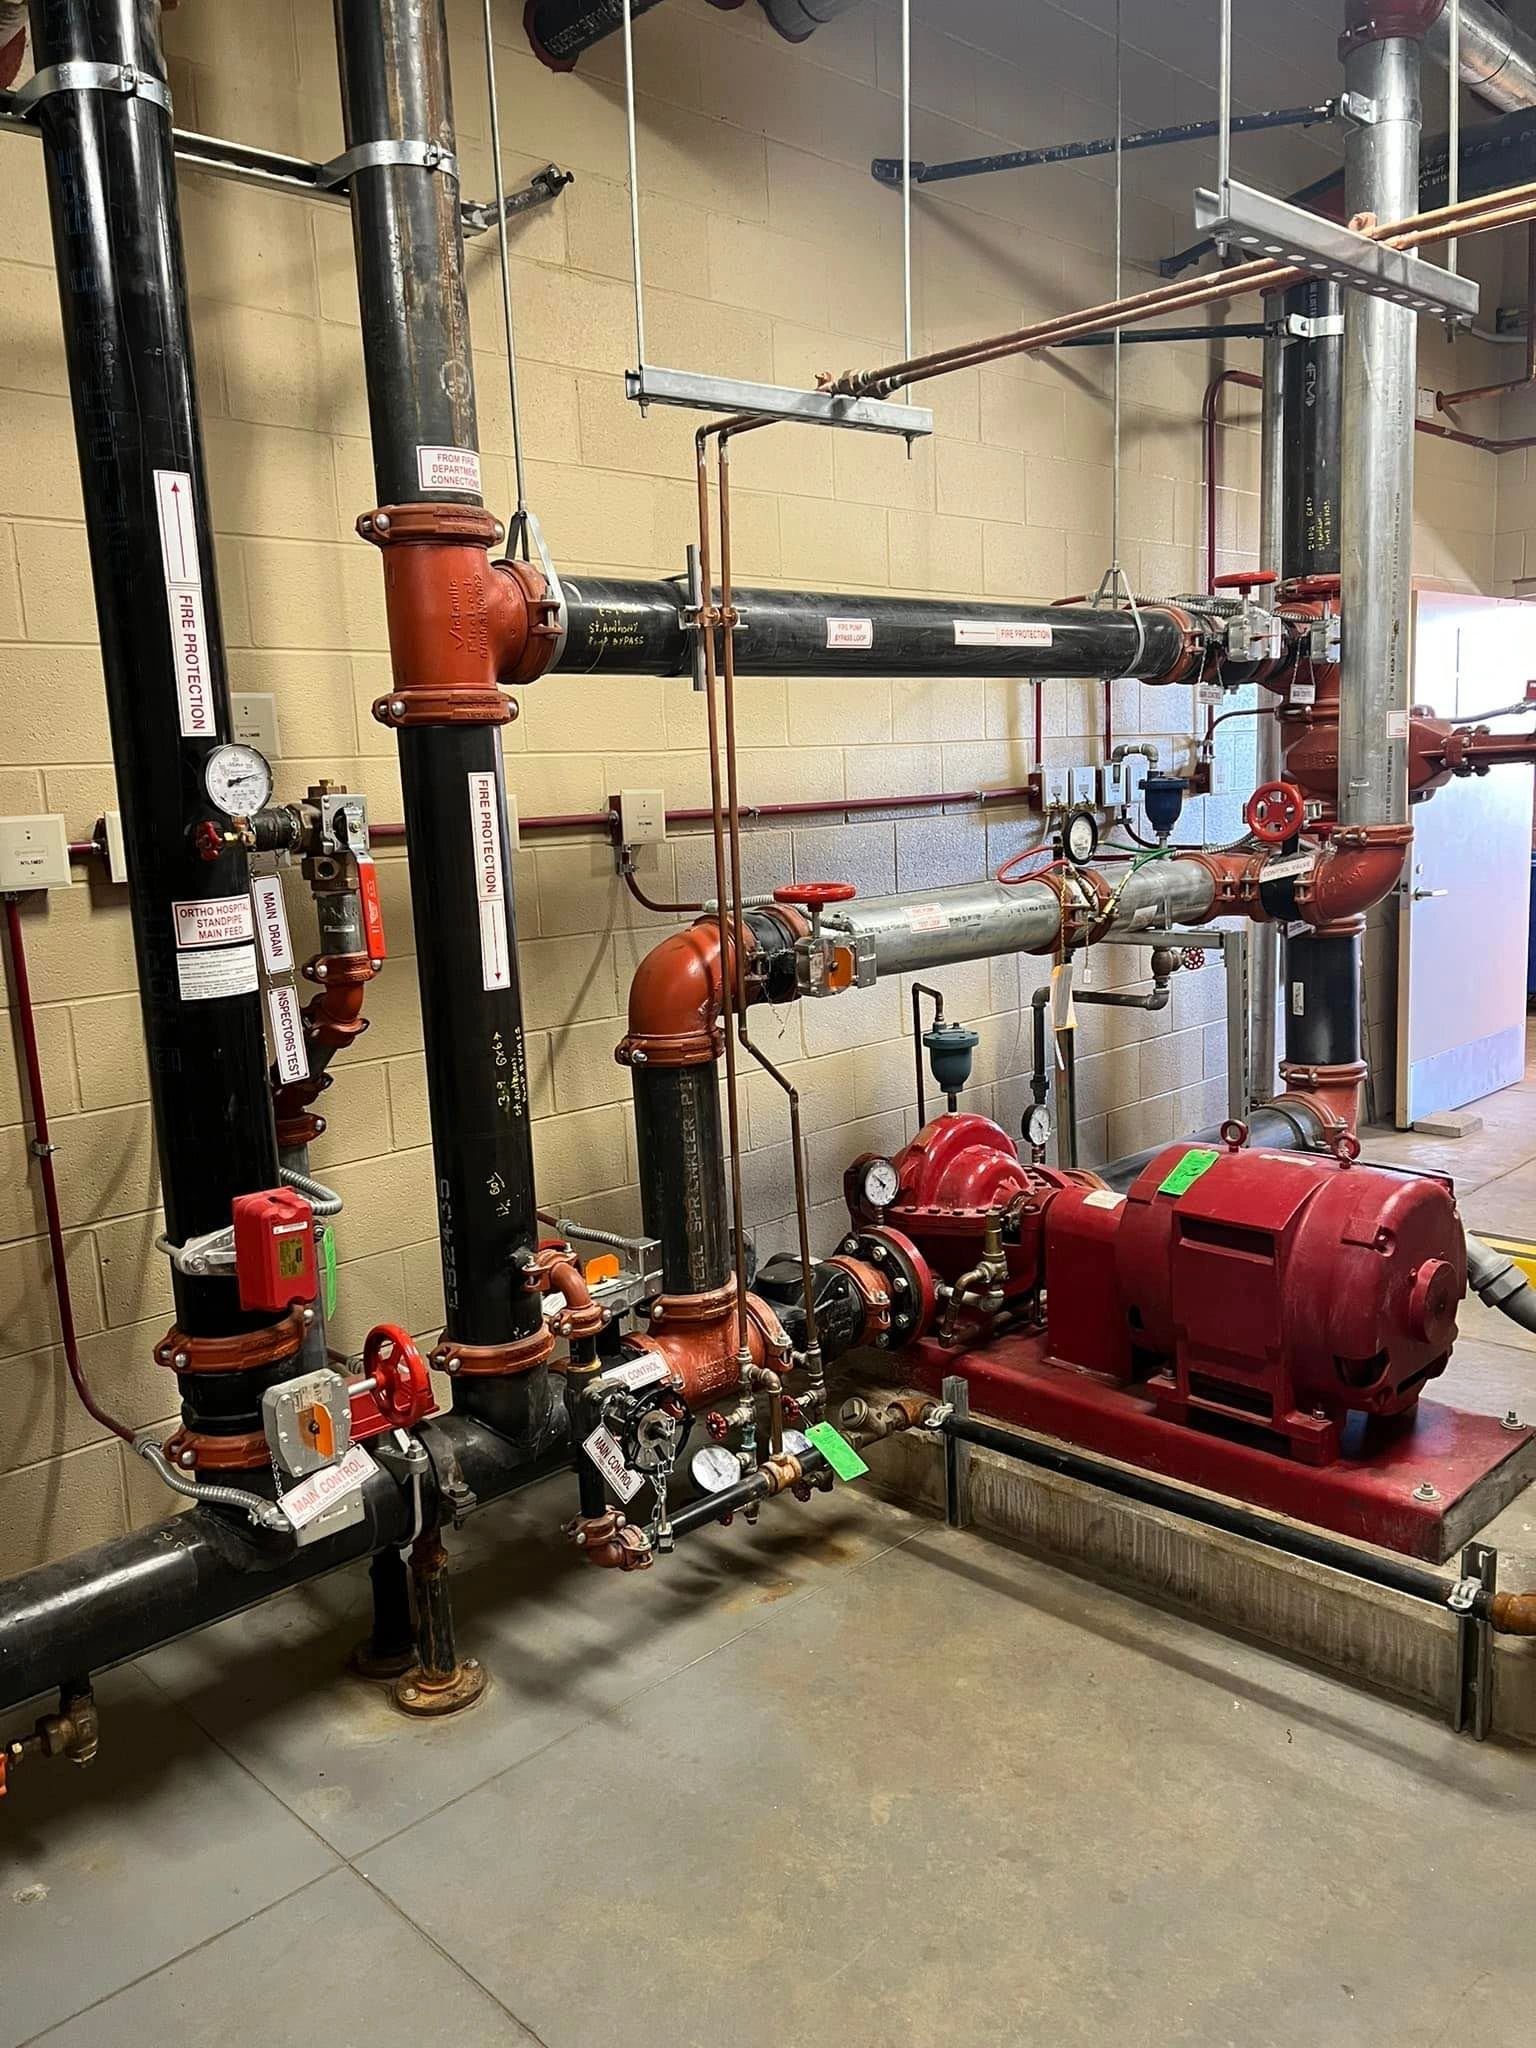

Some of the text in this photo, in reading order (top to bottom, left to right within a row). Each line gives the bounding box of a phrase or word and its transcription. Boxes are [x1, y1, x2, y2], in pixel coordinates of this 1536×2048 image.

[437, 454, 475, 467] FROM FIRE
[432, 464, 478, 478] DEPARTMENT
[431, 475, 480, 489] CONNECTION
[1001, 628, 1050, 640] FIRE PROTECTION
[179, 595, 206, 730] FIRE PROTECTION
[478, 779, 497, 893] FIRE PROTECTION
[180, 902, 248, 918] ORTHO HOSPITAL
[197, 914, 242, 929] STANDPIPE
[263, 891, 284, 957] MAIN DRAIN
[198, 925, 244, 940] MAIN FEED
[276, 990, 301, 1077] INSPECTORS TEST
[682, 1117, 703, 1233] SPRINKLER
[628, 1361, 661, 1381] CONTROL
[594, 1436, 611, 1459] MAIN
[607, 1454, 634, 1490] CONTROL
[292, 1488, 321, 1514] MAIN
[319, 1459, 365, 1494] CONTROL
